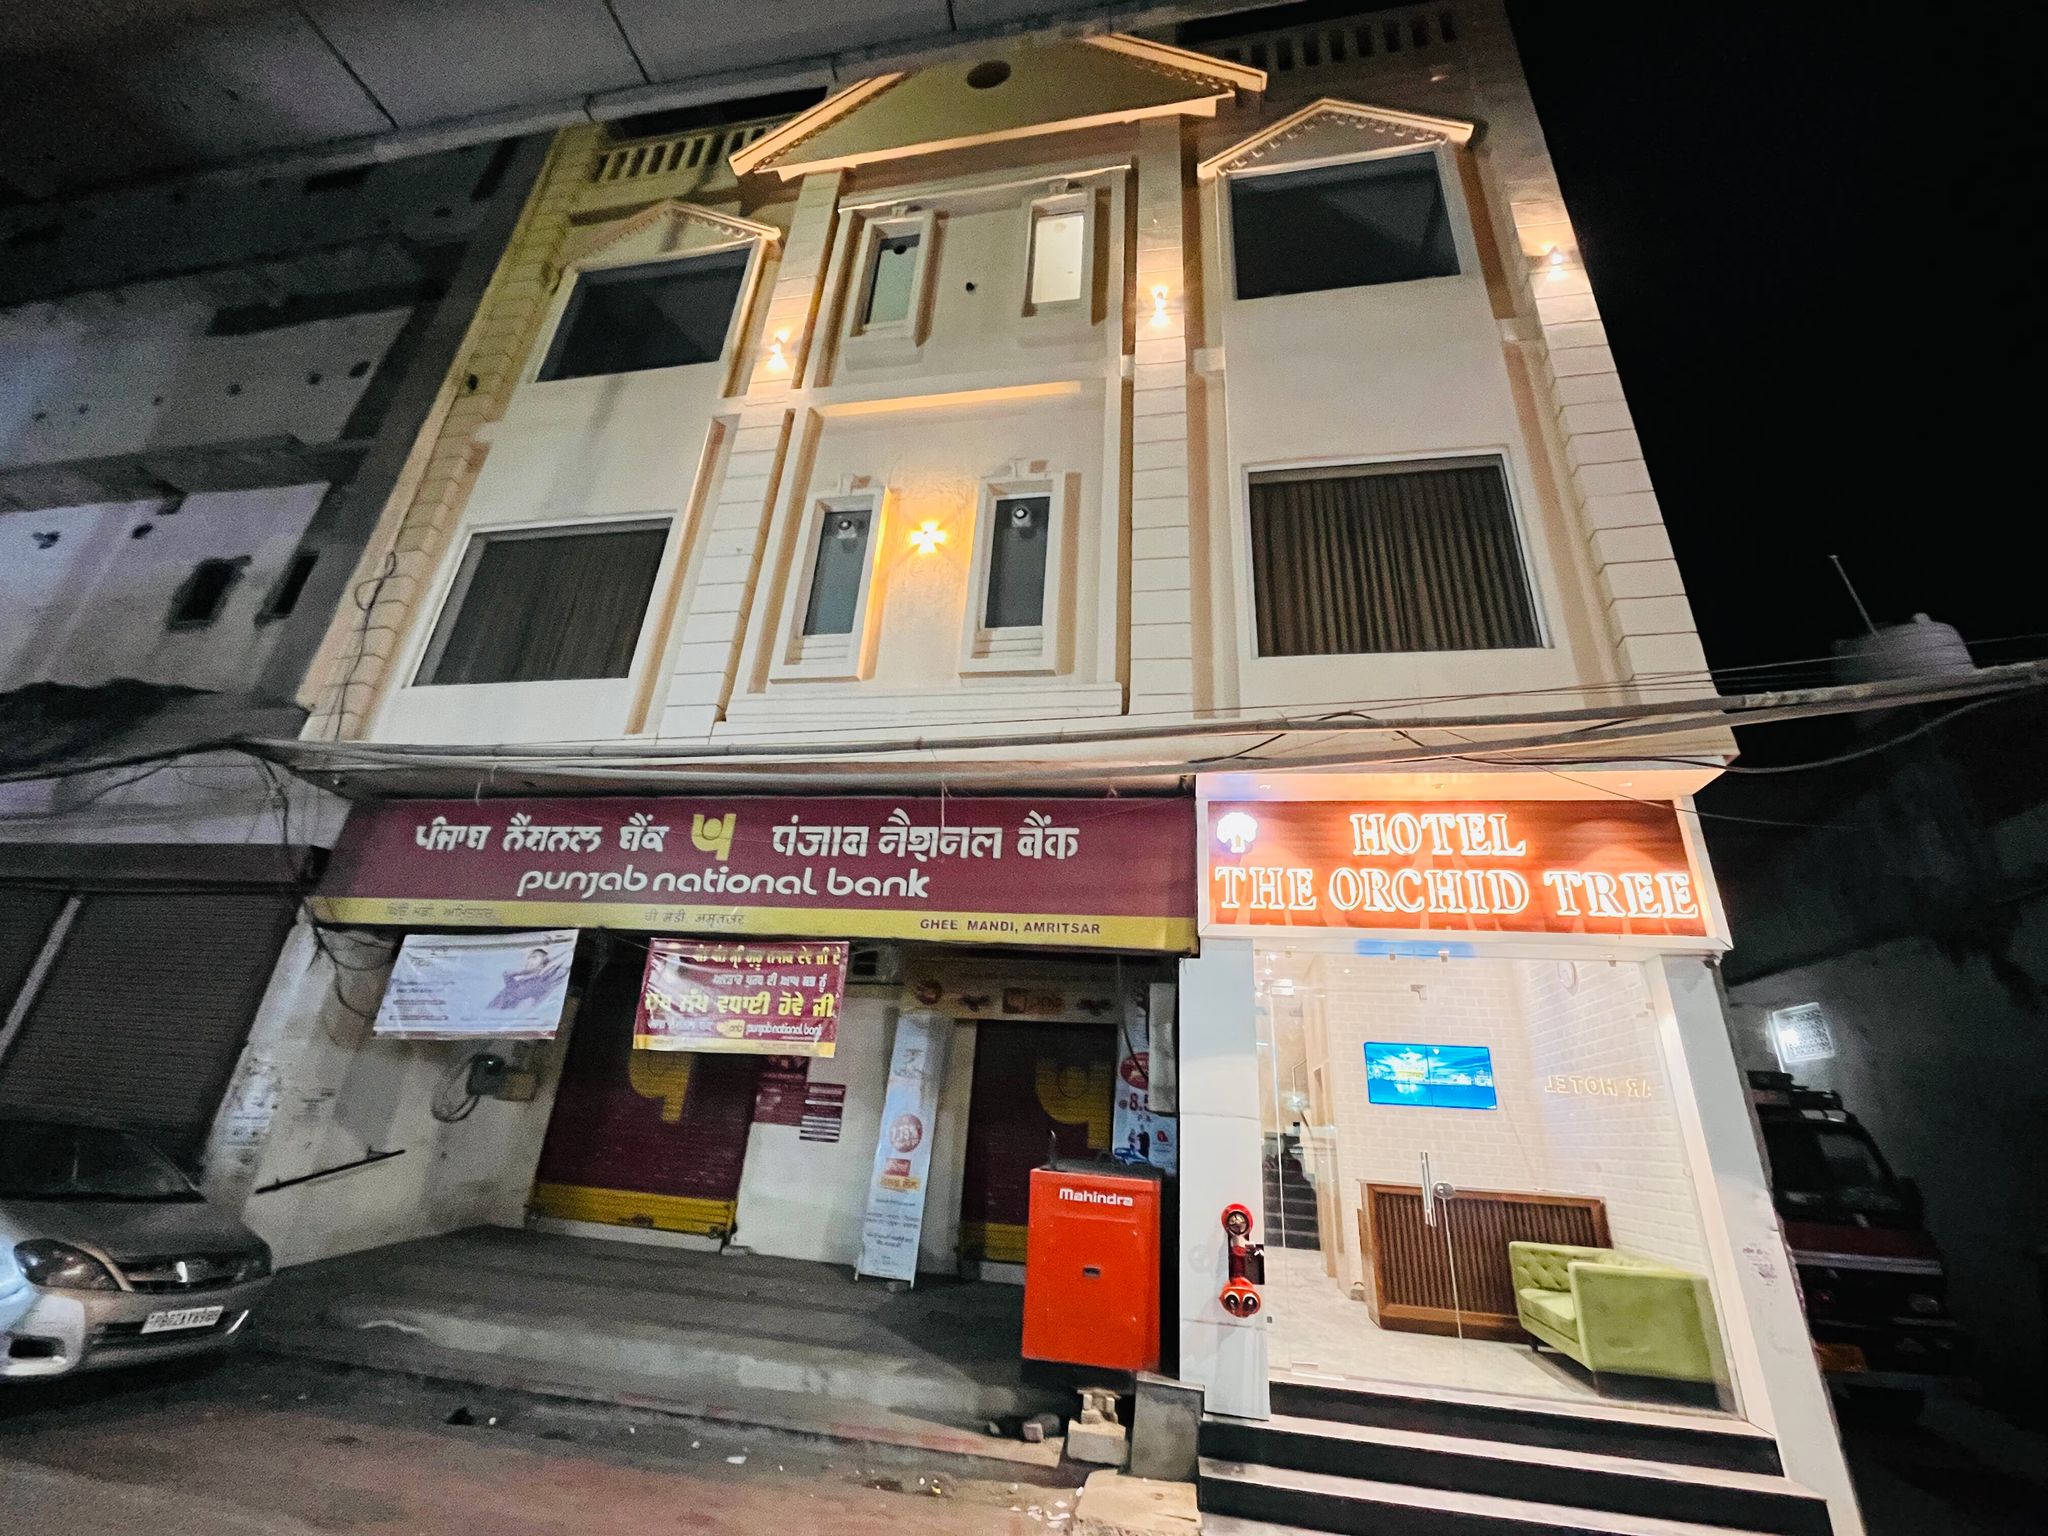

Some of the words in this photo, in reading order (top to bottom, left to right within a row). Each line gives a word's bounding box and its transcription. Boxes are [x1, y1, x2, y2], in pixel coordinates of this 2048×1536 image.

[416, 816, 492, 852] ਪੰਜਾਬ
[619, 812, 670, 853] ਬੈਂਕ
[772, 814, 870, 858] पंजाब
[878, 807, 1002, 862] नैशनल
[1016, 809, 1080, 860] बैंक
[1349, 811, 1528, 857] HOTEL
[517, 864, 648, 900] punjab
[652, 866, 818, 897] national
[826, 868, 931, 899] bank
[1214, 865, 1318, 912] THE
[1327, 867, 1530, 915] ORCHID
[1543, 870, 1699, 921] TREE
[919, 918, 959, 930] GHEE
[967, 920, 1019, 934] MANDI,
[1023, 921, 1101, 935] AMRITSAR
[717, 990, 772, 1016] ਵਧਾਈ
[778, 991, 805, 1017] ਹੋਵੇ
[1059, 1187, 1134, 1207] Mahindra
